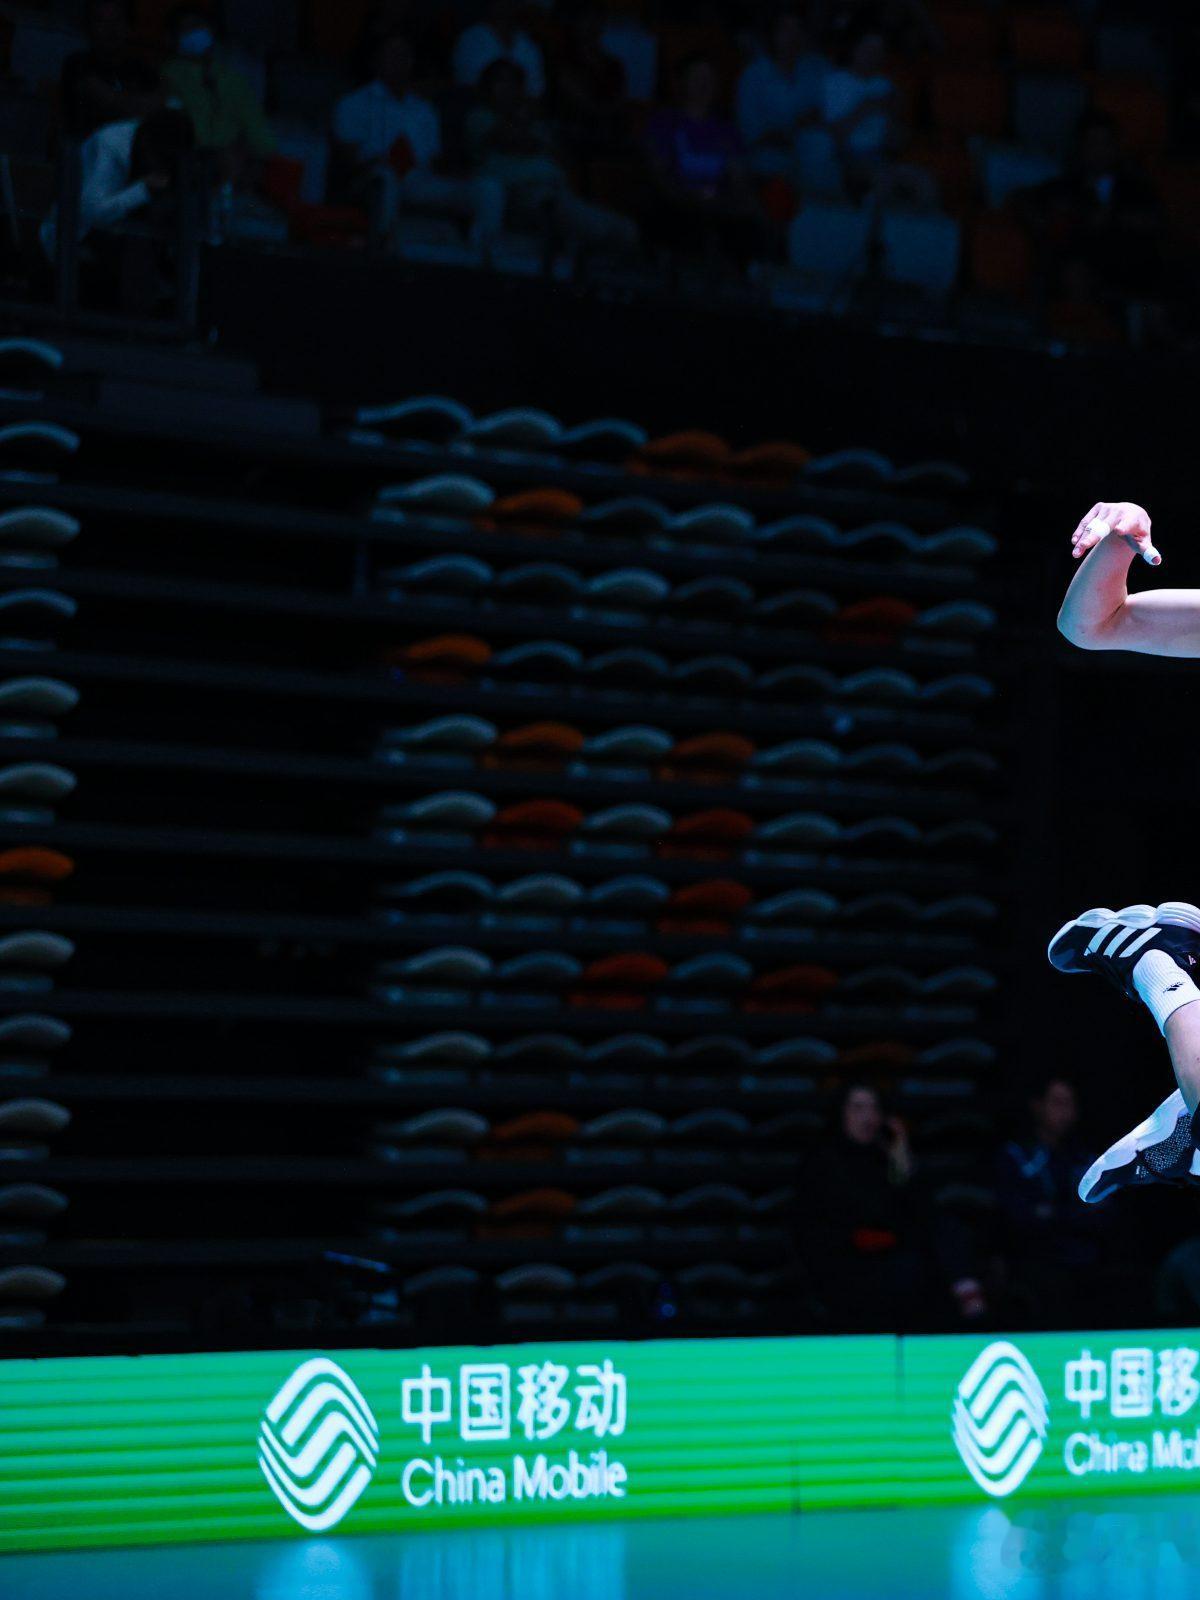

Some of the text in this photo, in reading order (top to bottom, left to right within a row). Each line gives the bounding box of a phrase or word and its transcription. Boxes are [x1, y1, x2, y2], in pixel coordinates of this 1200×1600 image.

[401, 1359, 628, 1445] 中国移动
[402, 1450, 628, 1507] China Mobile
[1064, 1431, 1148, 1476] China
